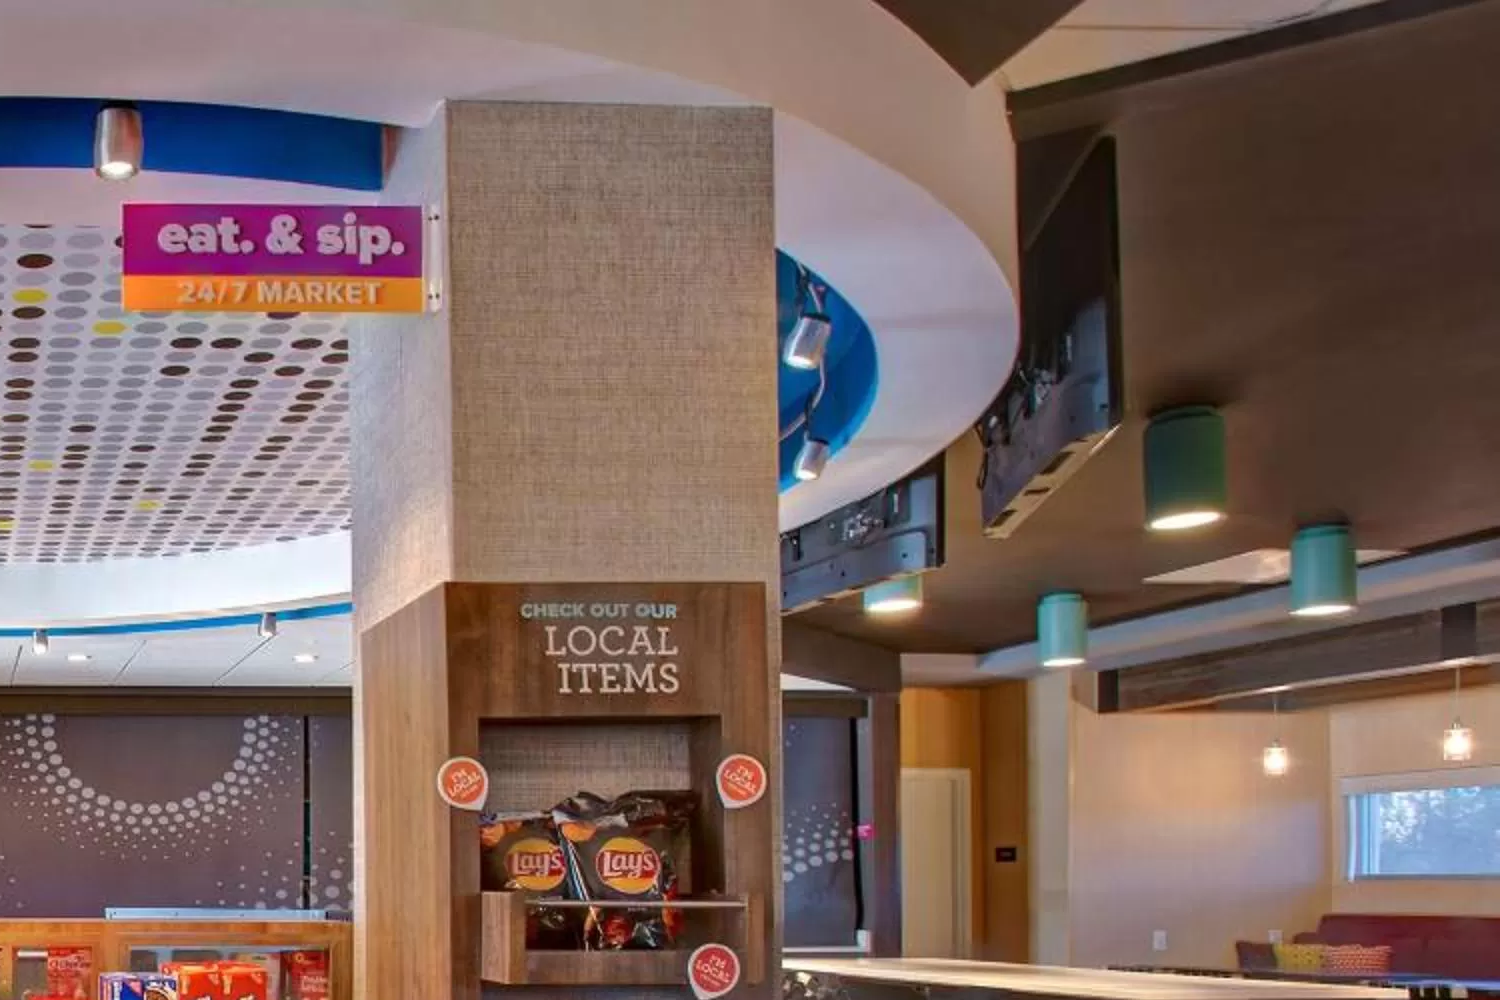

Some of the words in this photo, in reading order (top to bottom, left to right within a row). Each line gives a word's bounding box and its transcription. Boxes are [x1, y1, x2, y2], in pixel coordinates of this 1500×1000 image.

[157, 216, 254, 254] eat.
[266, 214, 304, 254] &
[317, 212, 405, 265] sip.
[178, 281, 246, 304] 24/7
[257, 281, 382, 304] MARKET
[521, 604, 585, 618] CHECK
[591, 604, 627, 618] OUT
[635, 604, 678, 618] OUR
[545, 626, 678, 655] LOCAL
[559, 663, 679, 693] ITEMS
[603, 848, 655, 879] Lay's
